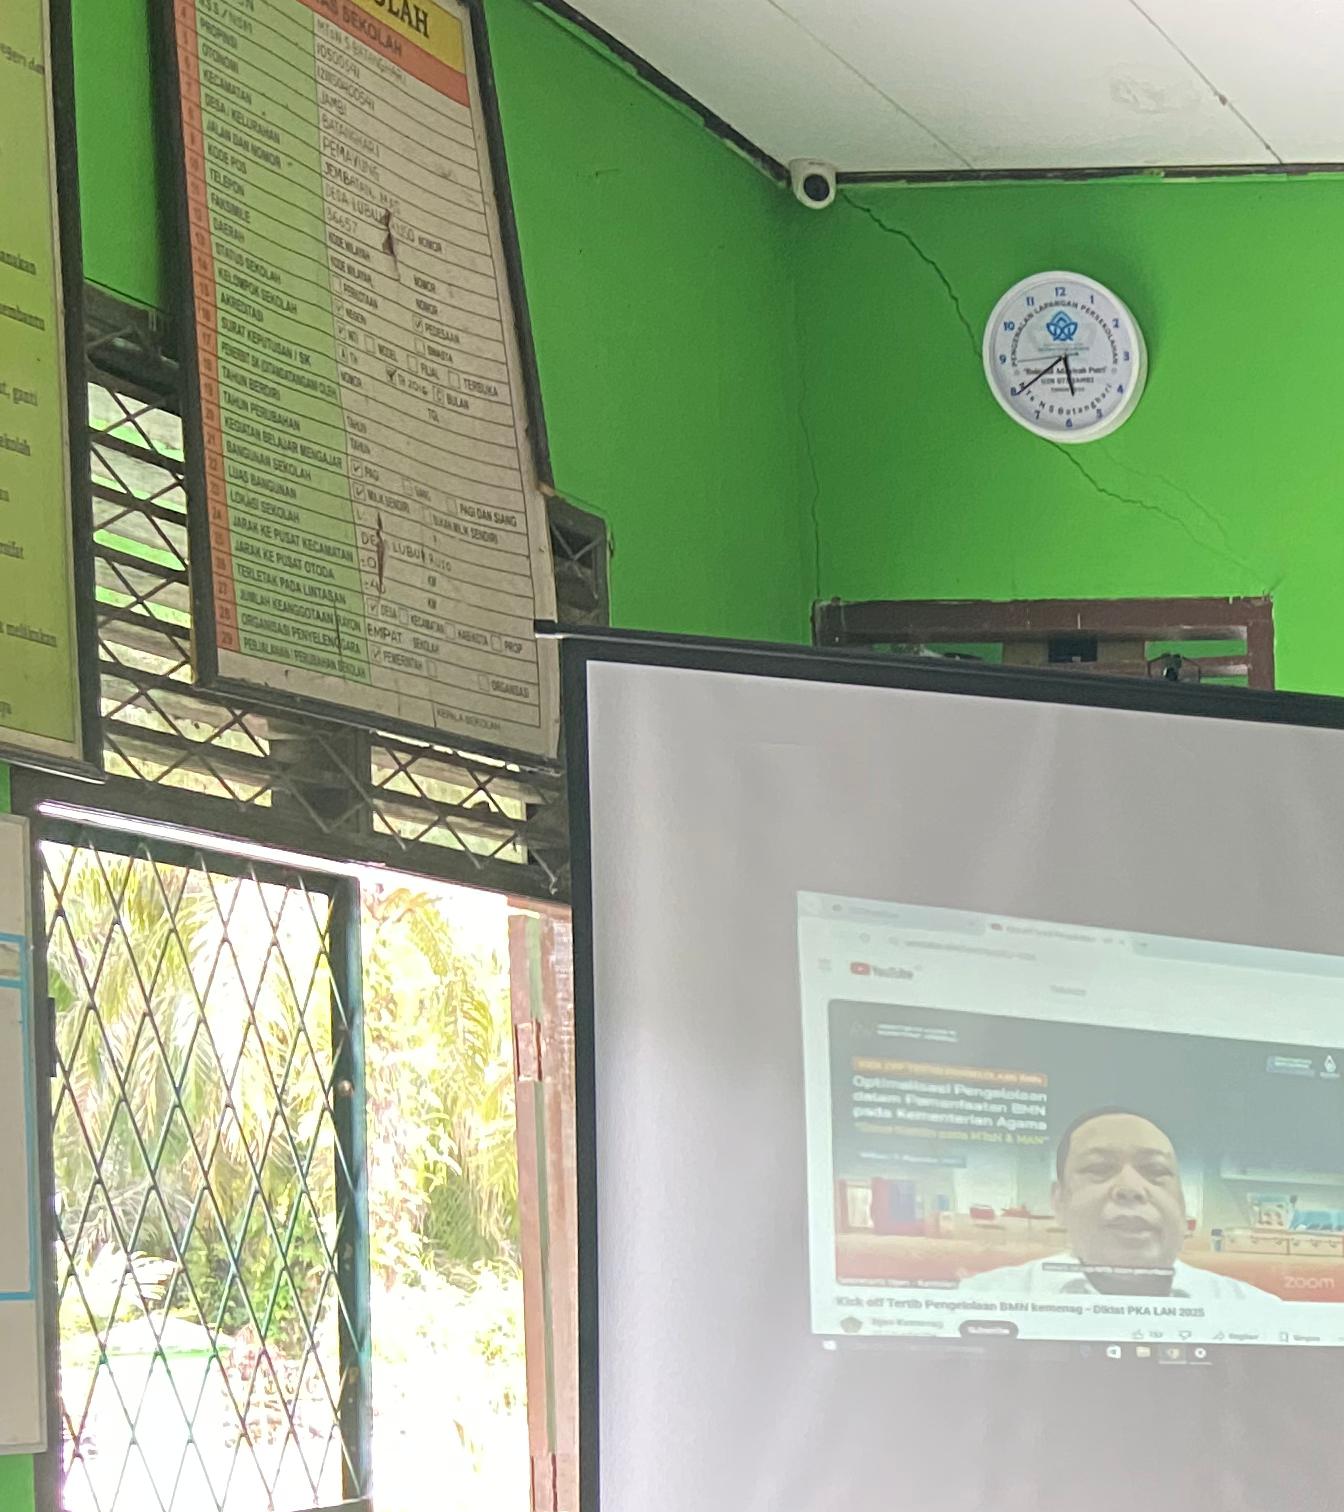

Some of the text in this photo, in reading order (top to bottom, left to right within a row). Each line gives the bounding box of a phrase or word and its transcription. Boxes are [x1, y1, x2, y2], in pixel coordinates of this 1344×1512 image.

[1055, 287, 1065, 297] 12
[1027, 297, 1034, 306] 11
[1090, 295, 1094, 303] 1
[1004, 322, 1014, 330] 10
[1117, 385, 1124, 394] 4
[1066, 419, 1072, 427] 6
[1284, 1273, 1335, 1292] zoom
